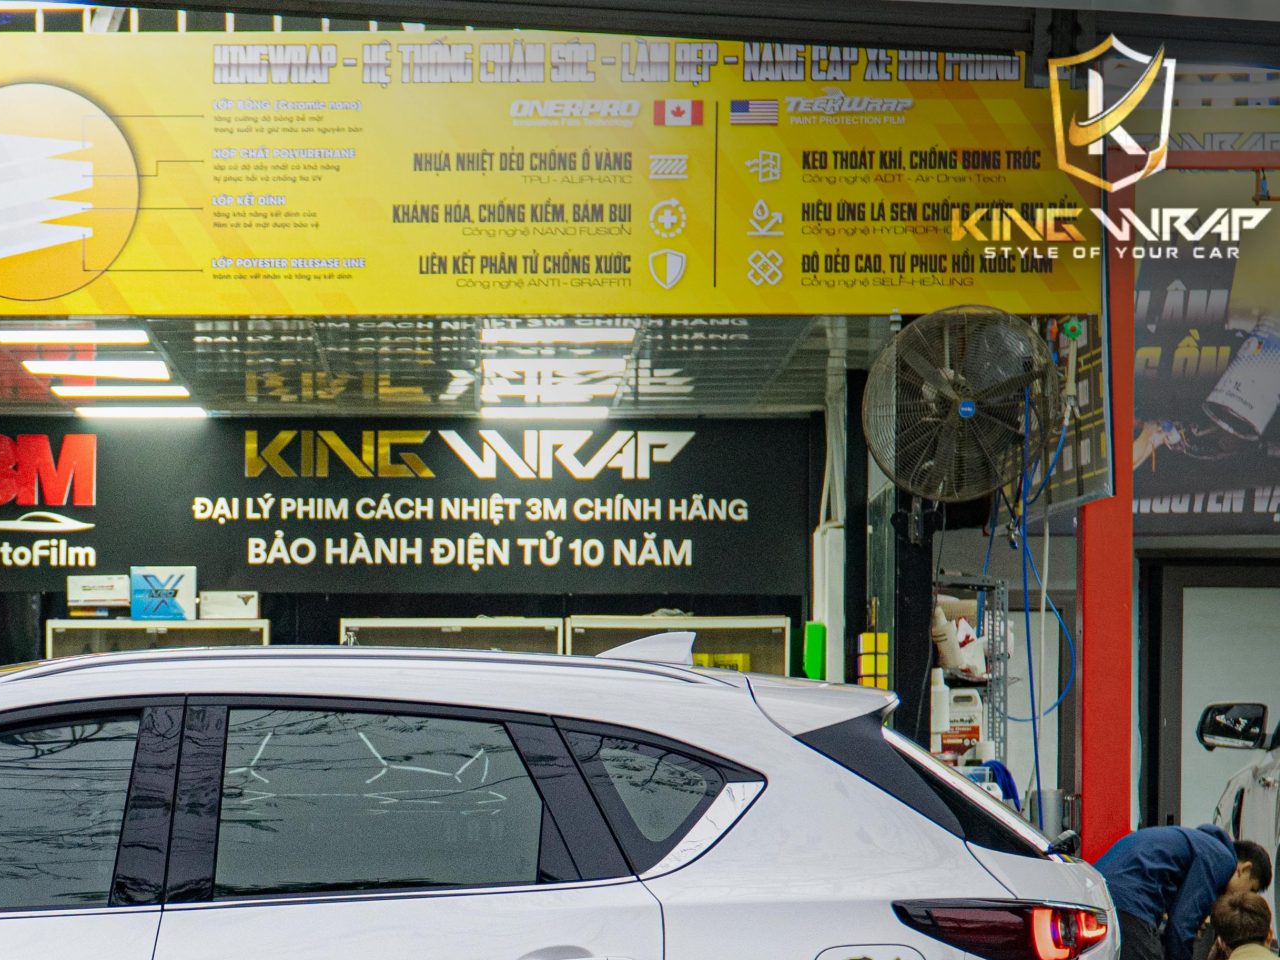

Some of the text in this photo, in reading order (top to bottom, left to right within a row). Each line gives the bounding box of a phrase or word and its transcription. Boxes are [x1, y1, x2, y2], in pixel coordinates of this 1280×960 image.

[361, 40, 393, 88] HỆ
[397, 36, 474, 84] THỐNG
[550, 38, 597, 83] SÓC
[621, 38, 670, 83] LÀM
[790, 116, 905, 125] PAINT PROTECTION FILM
[413, 150, 451, 177] NHỰA
[456, 148, 494, 177] NHIỆT
[499, 146, 524, 172] DẺO
[529, 145, 577, 172] CHỐNG
[595, 149, 633, 172] VÀNG
[802, 150, 828, 171] KEO
[832, 147, 875, 171] THOÁT
[909, 144, 958, 170] CHỐNG
[962, 150, 1000, 170] BONG
[1005, 147, 1041, 170] TRÓC
[522, 175, 633, 184] TPU ALIPHATIC
[973, 174, 1007, 183] Tech
[392, 200, 440, 224] KHÁNG
[478, 197, 526, 224] CHỐNG
[572, 200, 604, 224] BÁM
[801, 198, 832, 226] HIỆU
[870, 198, 887, 222] LÁ
[890, 202, 918, 222] SEN
[532, 227, 577, 236] NANO
[579, 227, 632, 236] FUSION
[419, 251, 448, 275] LIÊN
[452, 248, 477, 275] KẾT
[480, 251, 518, 275] PHÂN
[543, 248, 591, 275] CHỐNG
[527, 278, 561, 288] ANTI
[244, 430, 697, 480] KING WRAP
[192, 492, 750, 528] ĐẠI LÝ PHIM CÁCH NHIỆT 3M CHÍNH HÃNG
[247, 529, 694, 573] BẢO HÀNH ĐIỆN TỬ 10 NĂM
